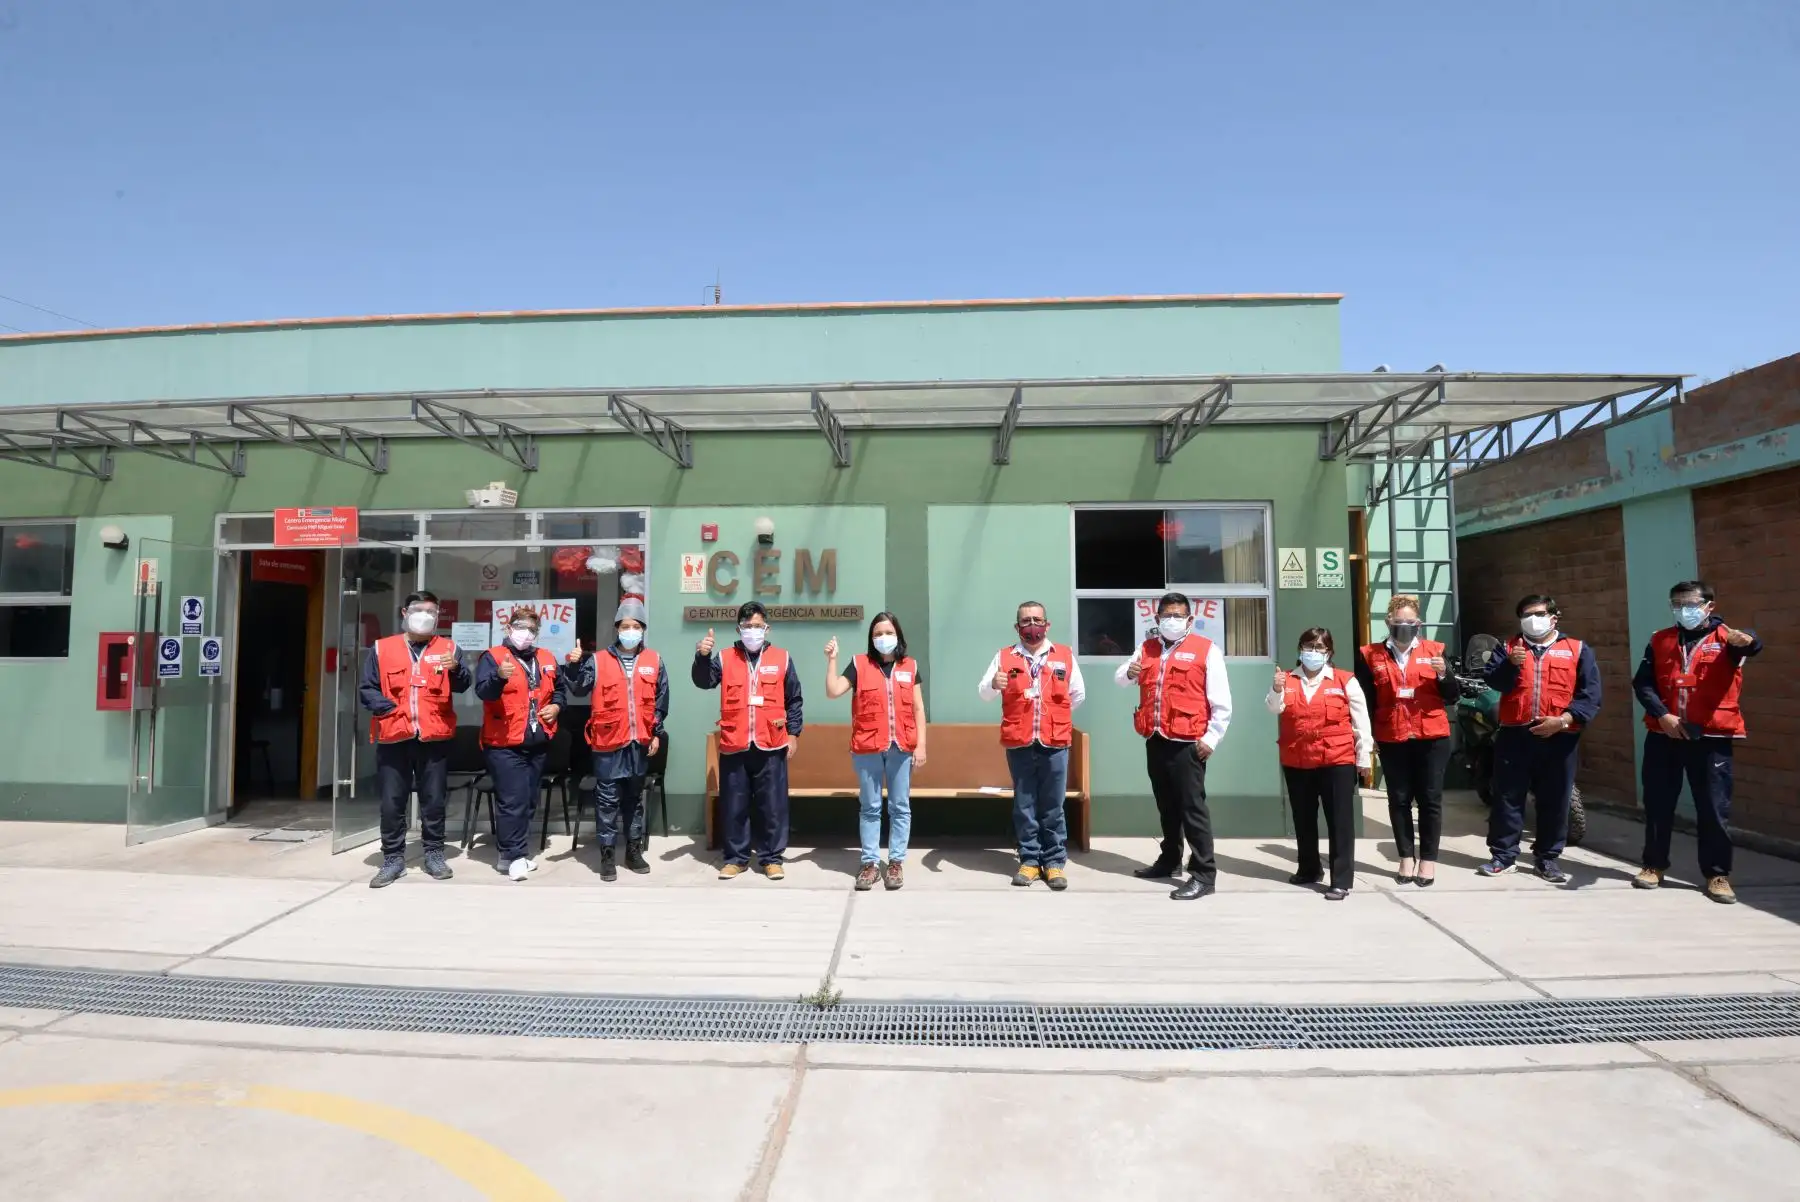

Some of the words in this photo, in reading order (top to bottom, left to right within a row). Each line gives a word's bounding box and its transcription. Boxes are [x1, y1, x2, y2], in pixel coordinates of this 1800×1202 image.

[1323, 551, 1338, 571] S
[708, 549, 837, 594] CEM
[689, 608, 737, 618] CENTRO
[766, 608, 815, 618] RGENCIA
[820, 607, 858, 618] MUJER
[1136, 598, 1218, 618] STE
